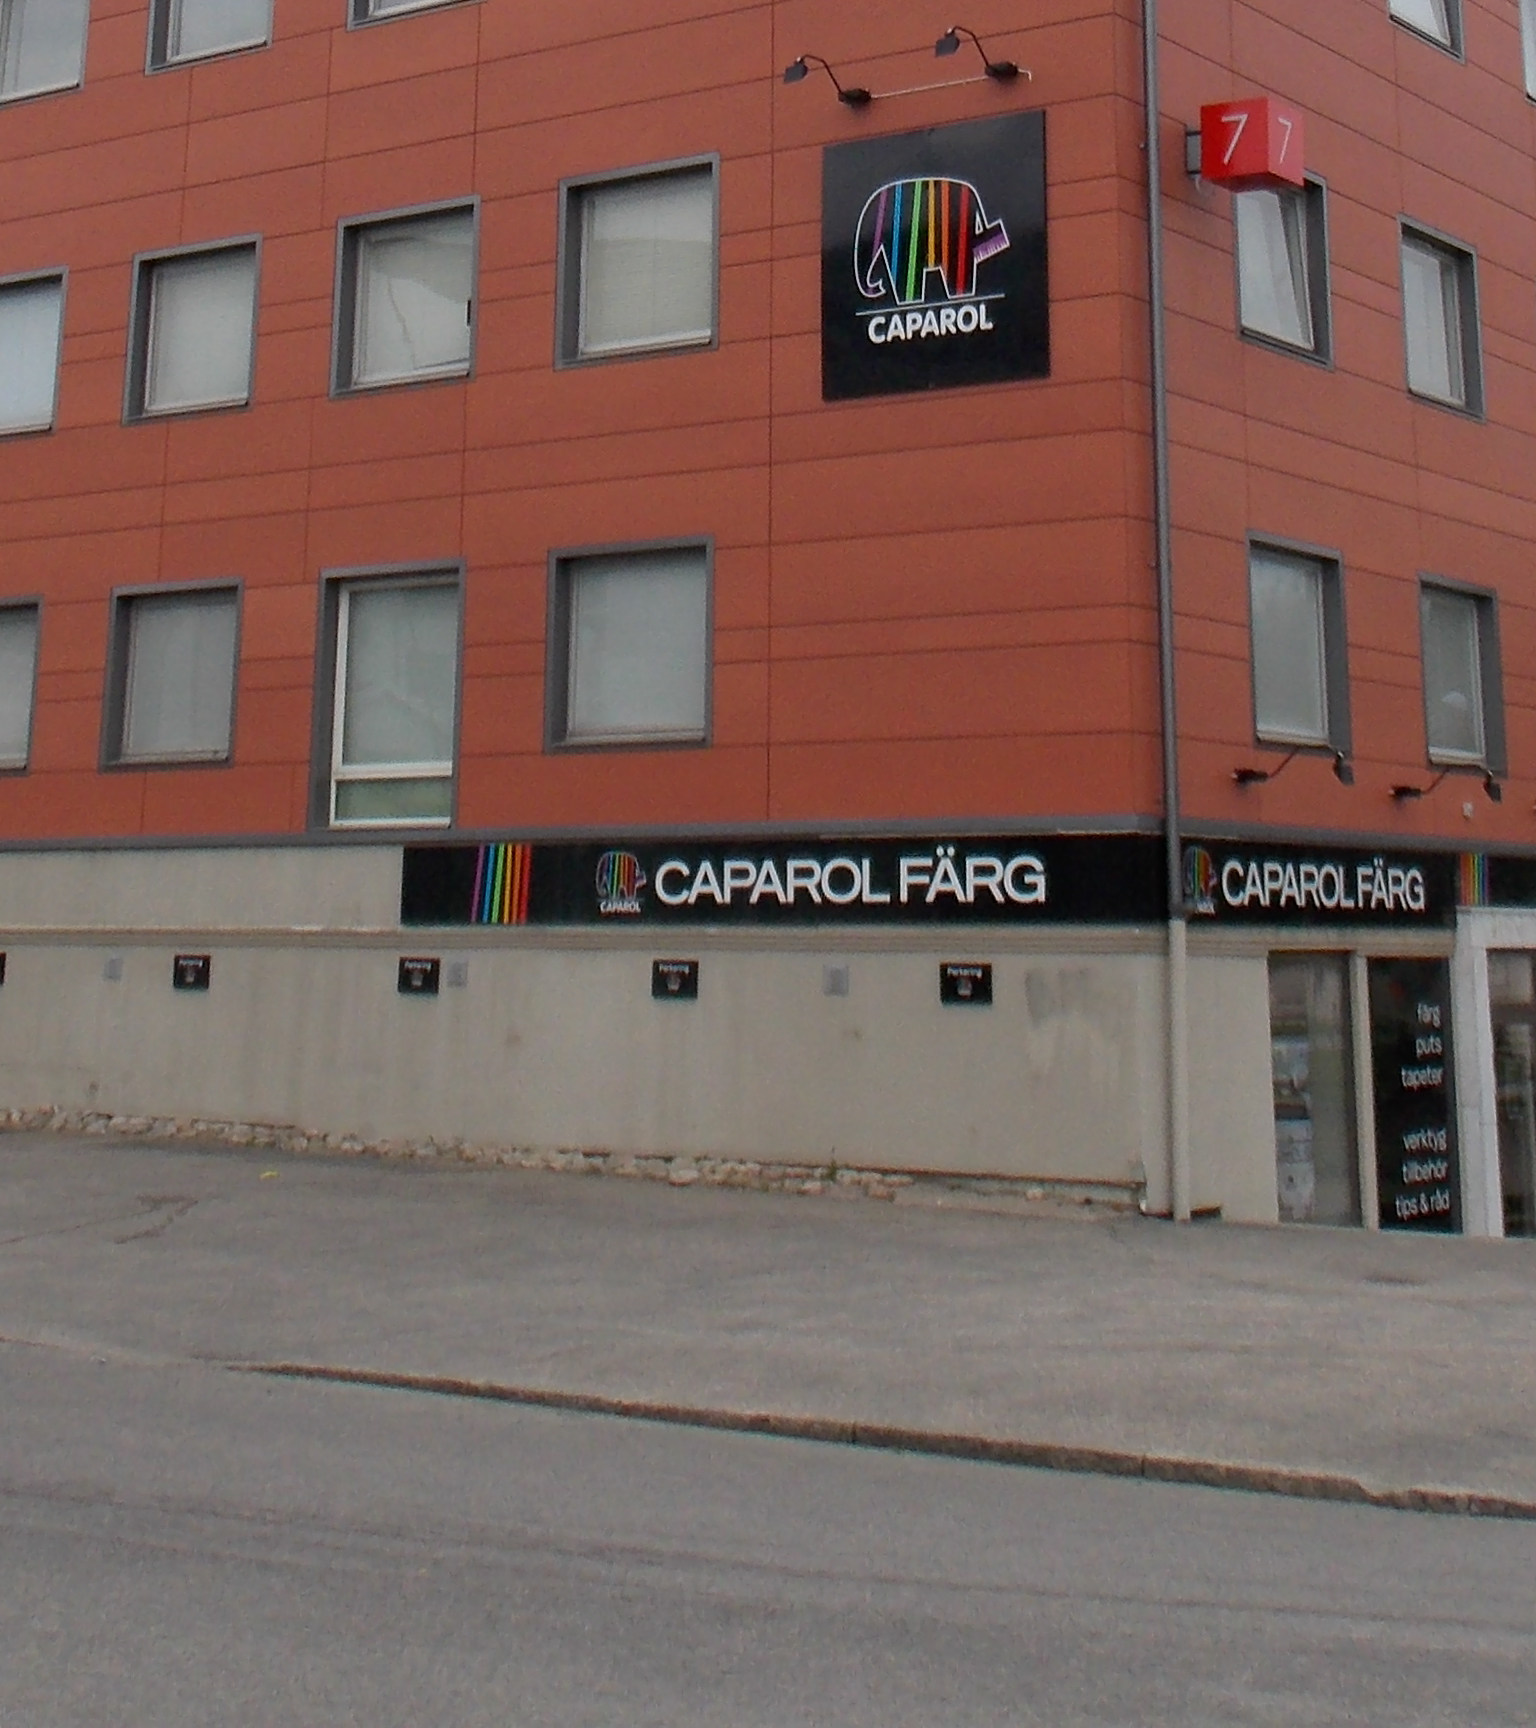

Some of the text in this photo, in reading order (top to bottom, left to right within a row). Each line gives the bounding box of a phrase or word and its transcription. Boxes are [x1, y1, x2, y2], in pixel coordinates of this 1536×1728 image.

[1222, 113, 1248, 165] 7
[1278, 117, 1292, 164] 7
[868, 304, 993, 344] CAPAROL
[655, 845, 1046, 905] CAPAROL FÄRG
[1221, 857, 1425, 912] CAPAROL FÄRG
[600, 901, 641, 913] CAPAROL
[1416, 1035, 1442, 1058] puts
[1403, 1129, 1447, 1152] verktyg
[1395, 1187, 1450, 1221] tips & råd
